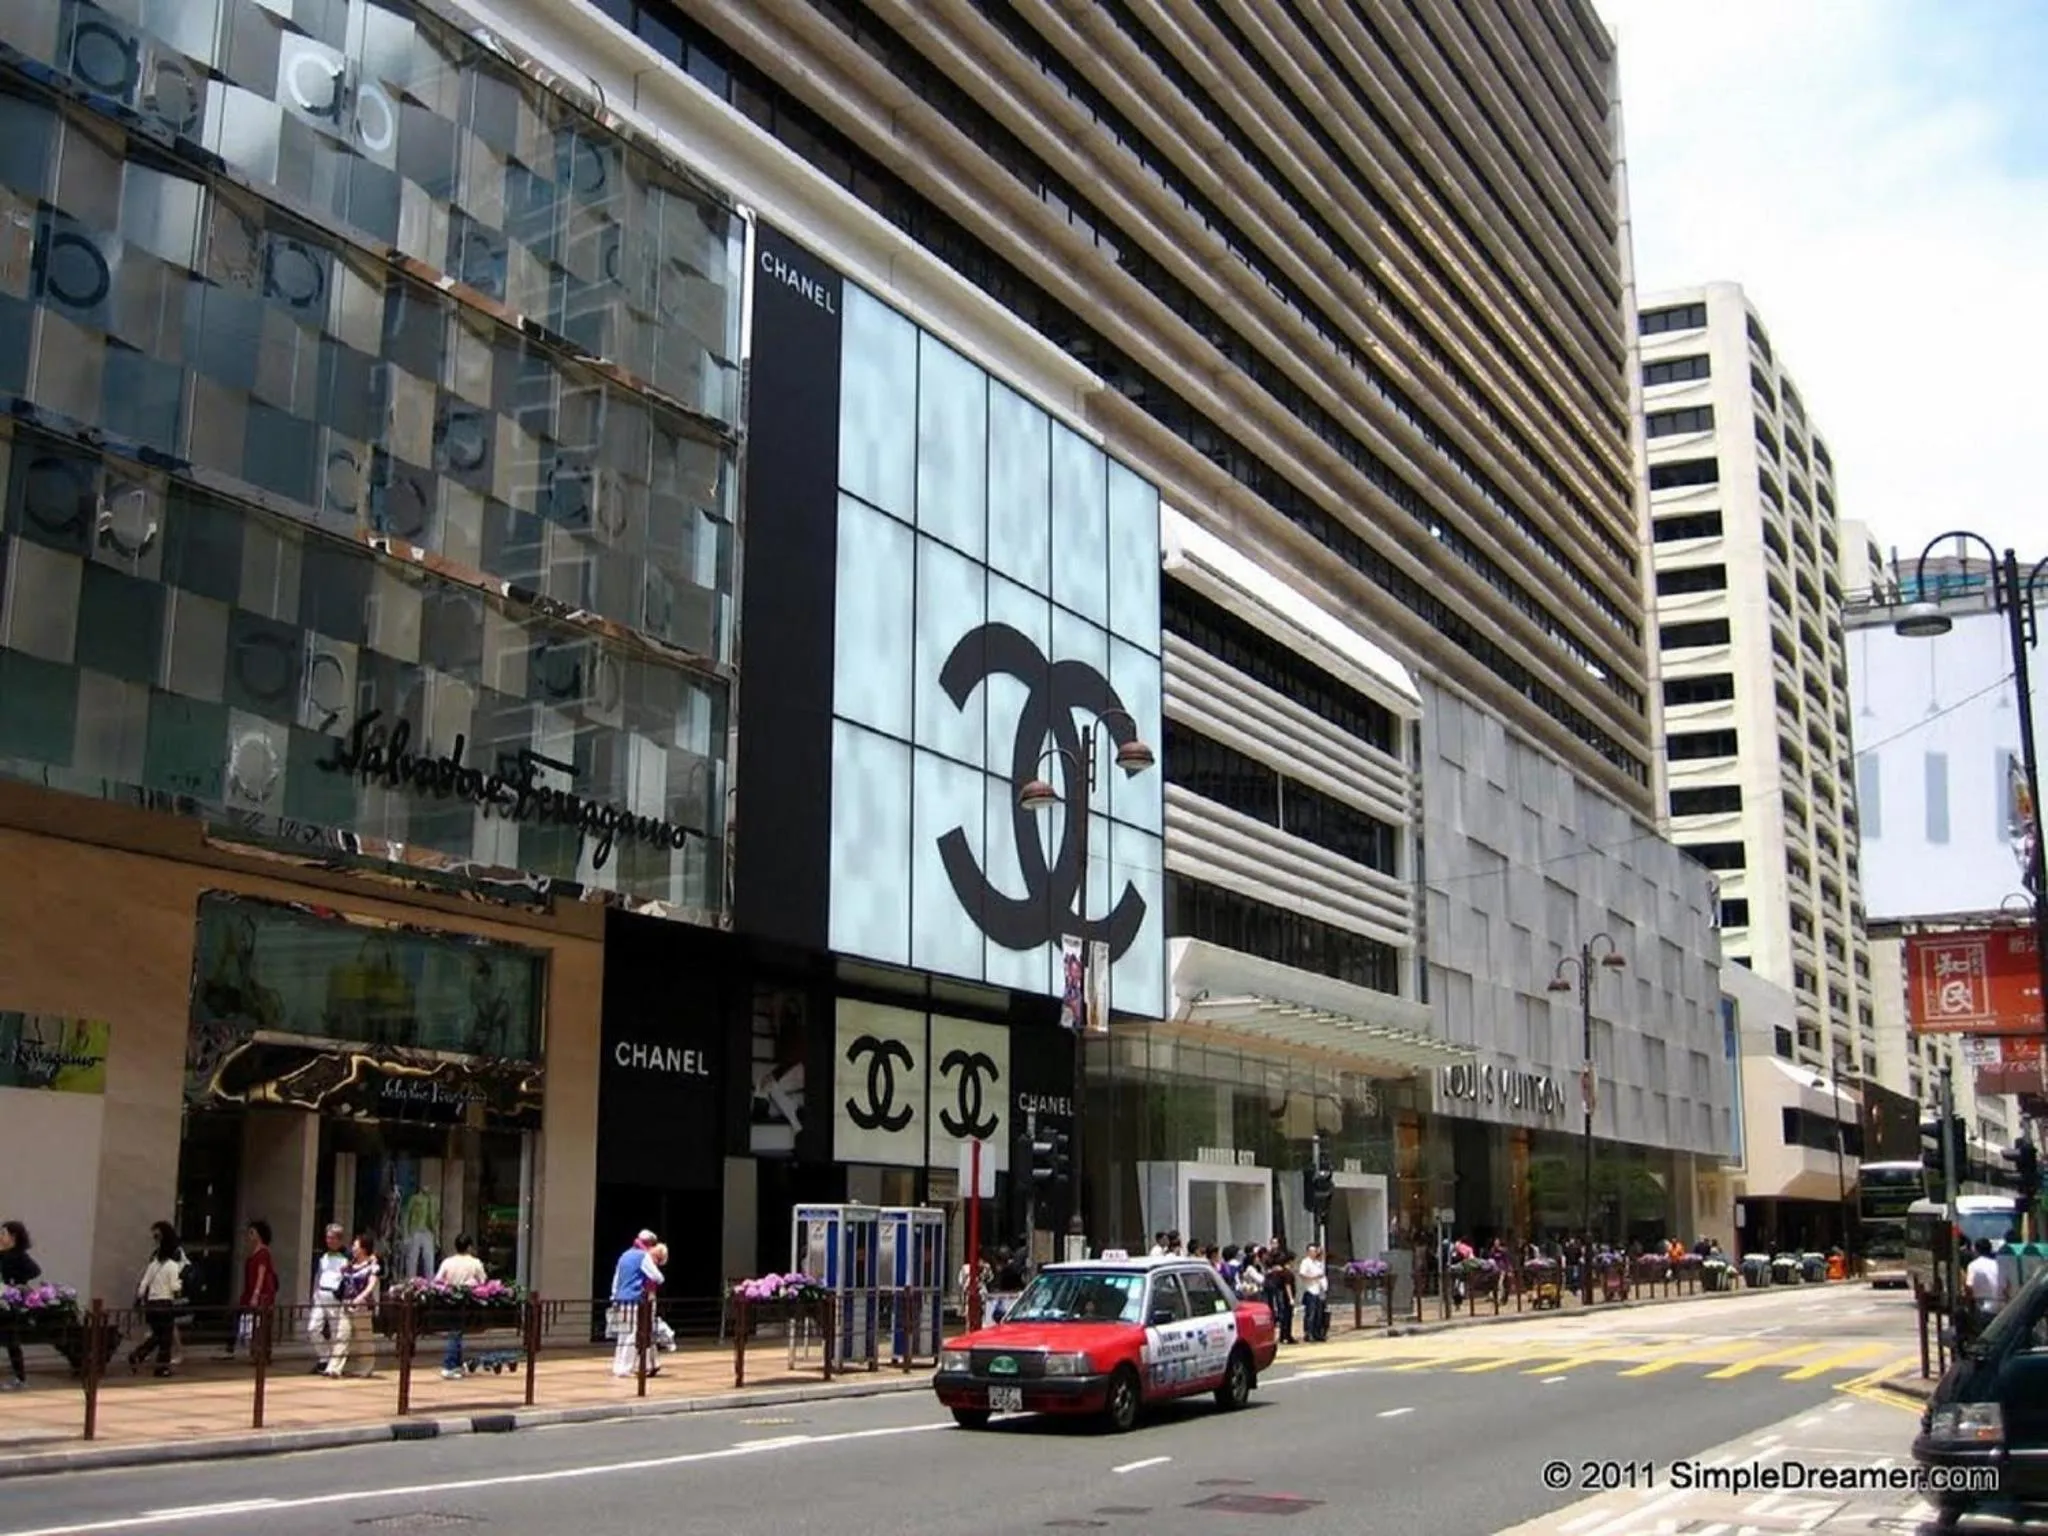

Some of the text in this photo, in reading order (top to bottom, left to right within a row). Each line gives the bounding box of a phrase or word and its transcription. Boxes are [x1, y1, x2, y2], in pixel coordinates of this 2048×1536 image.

[761, 250, 836, 315] CHANEL
[315, 708, 512, 802] Salvatore
[615, 1041, 710, 1075] CHANEL
[1019, 1092, 1077, 1117] CHANEL
[1441, 1064, 1566, 1117] LOUIS VUITTON
